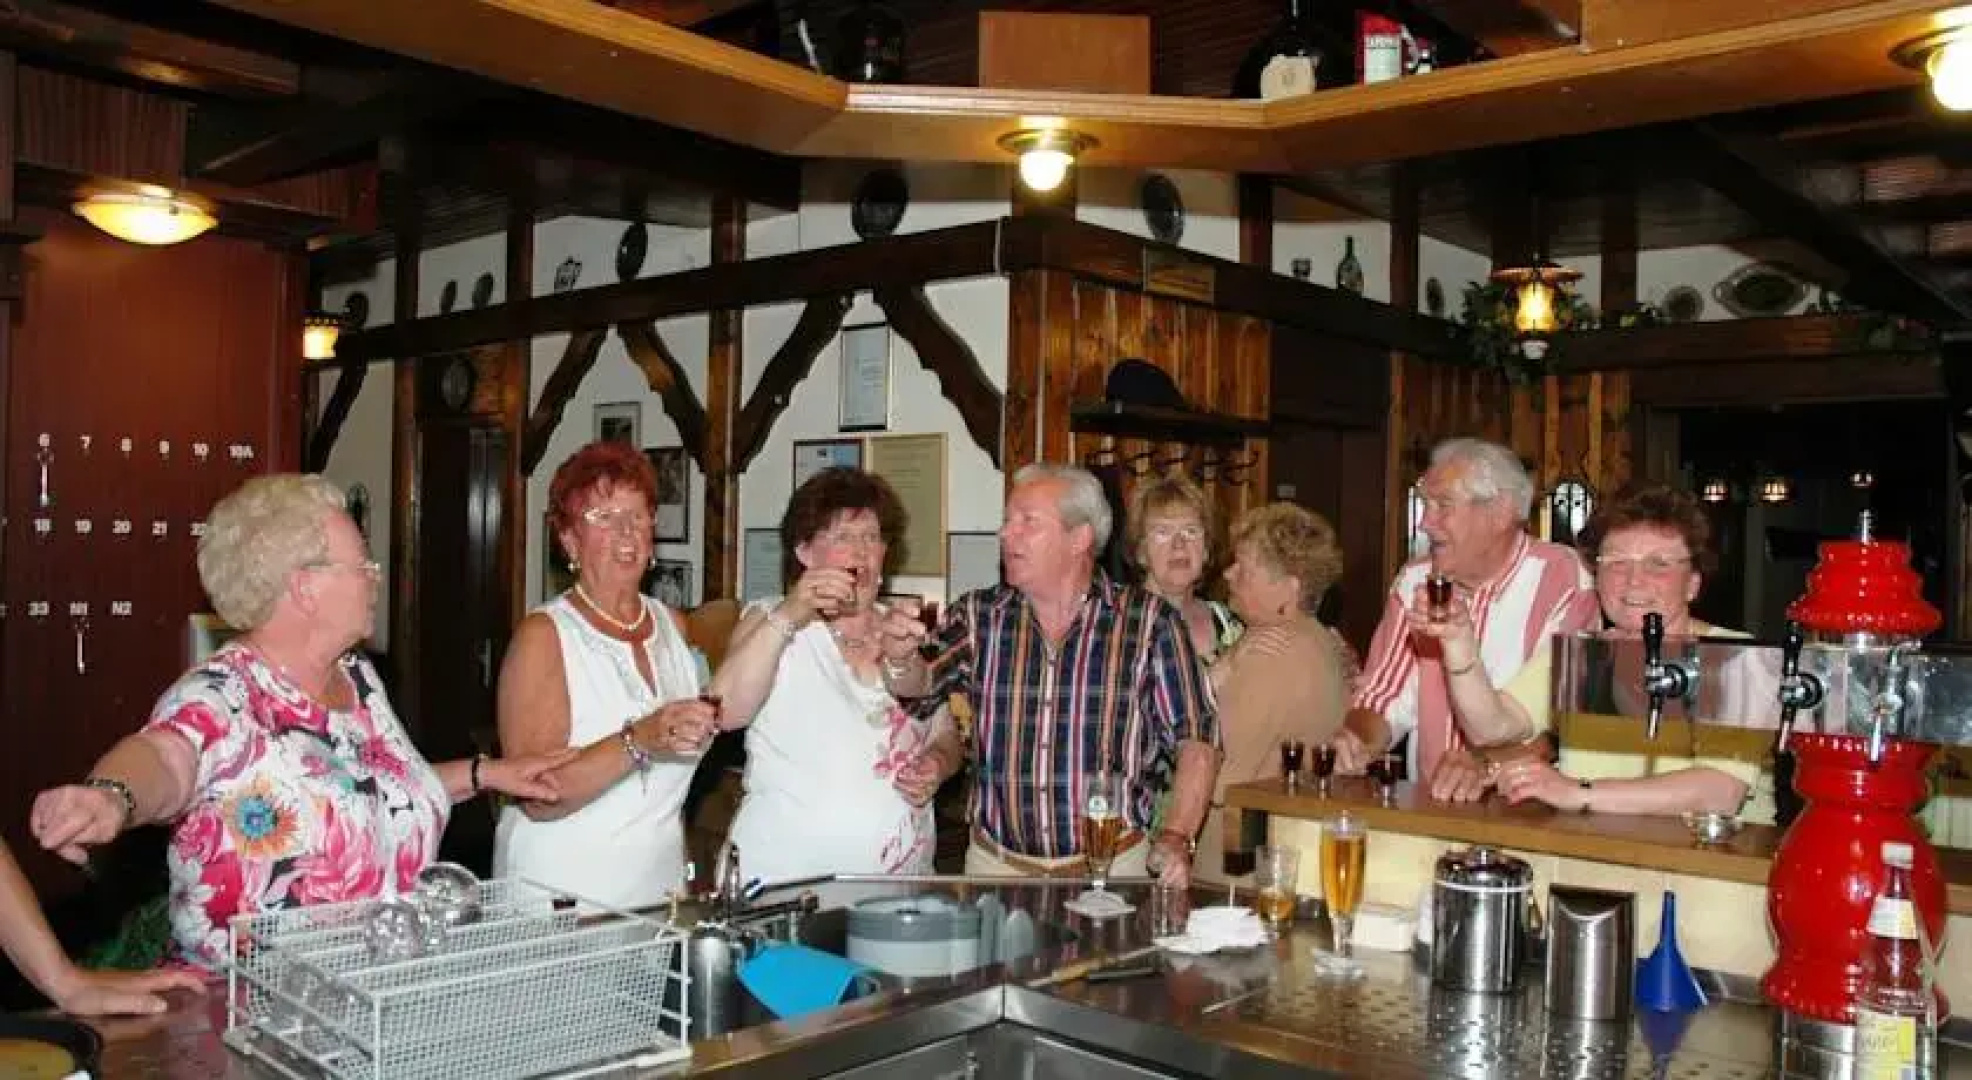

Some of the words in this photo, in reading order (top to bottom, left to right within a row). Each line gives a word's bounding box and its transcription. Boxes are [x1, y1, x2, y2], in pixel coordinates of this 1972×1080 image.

[80, 434, 91, 449] 7
[193, 443, 209, 456] 10
[229, 445, 254, 459] 10A
[75, 520, 91, 534] 19
[113, 520, 132, 534] 20
[152, 521, 168, 535] 21
[112, 600, 132, 616] N2
